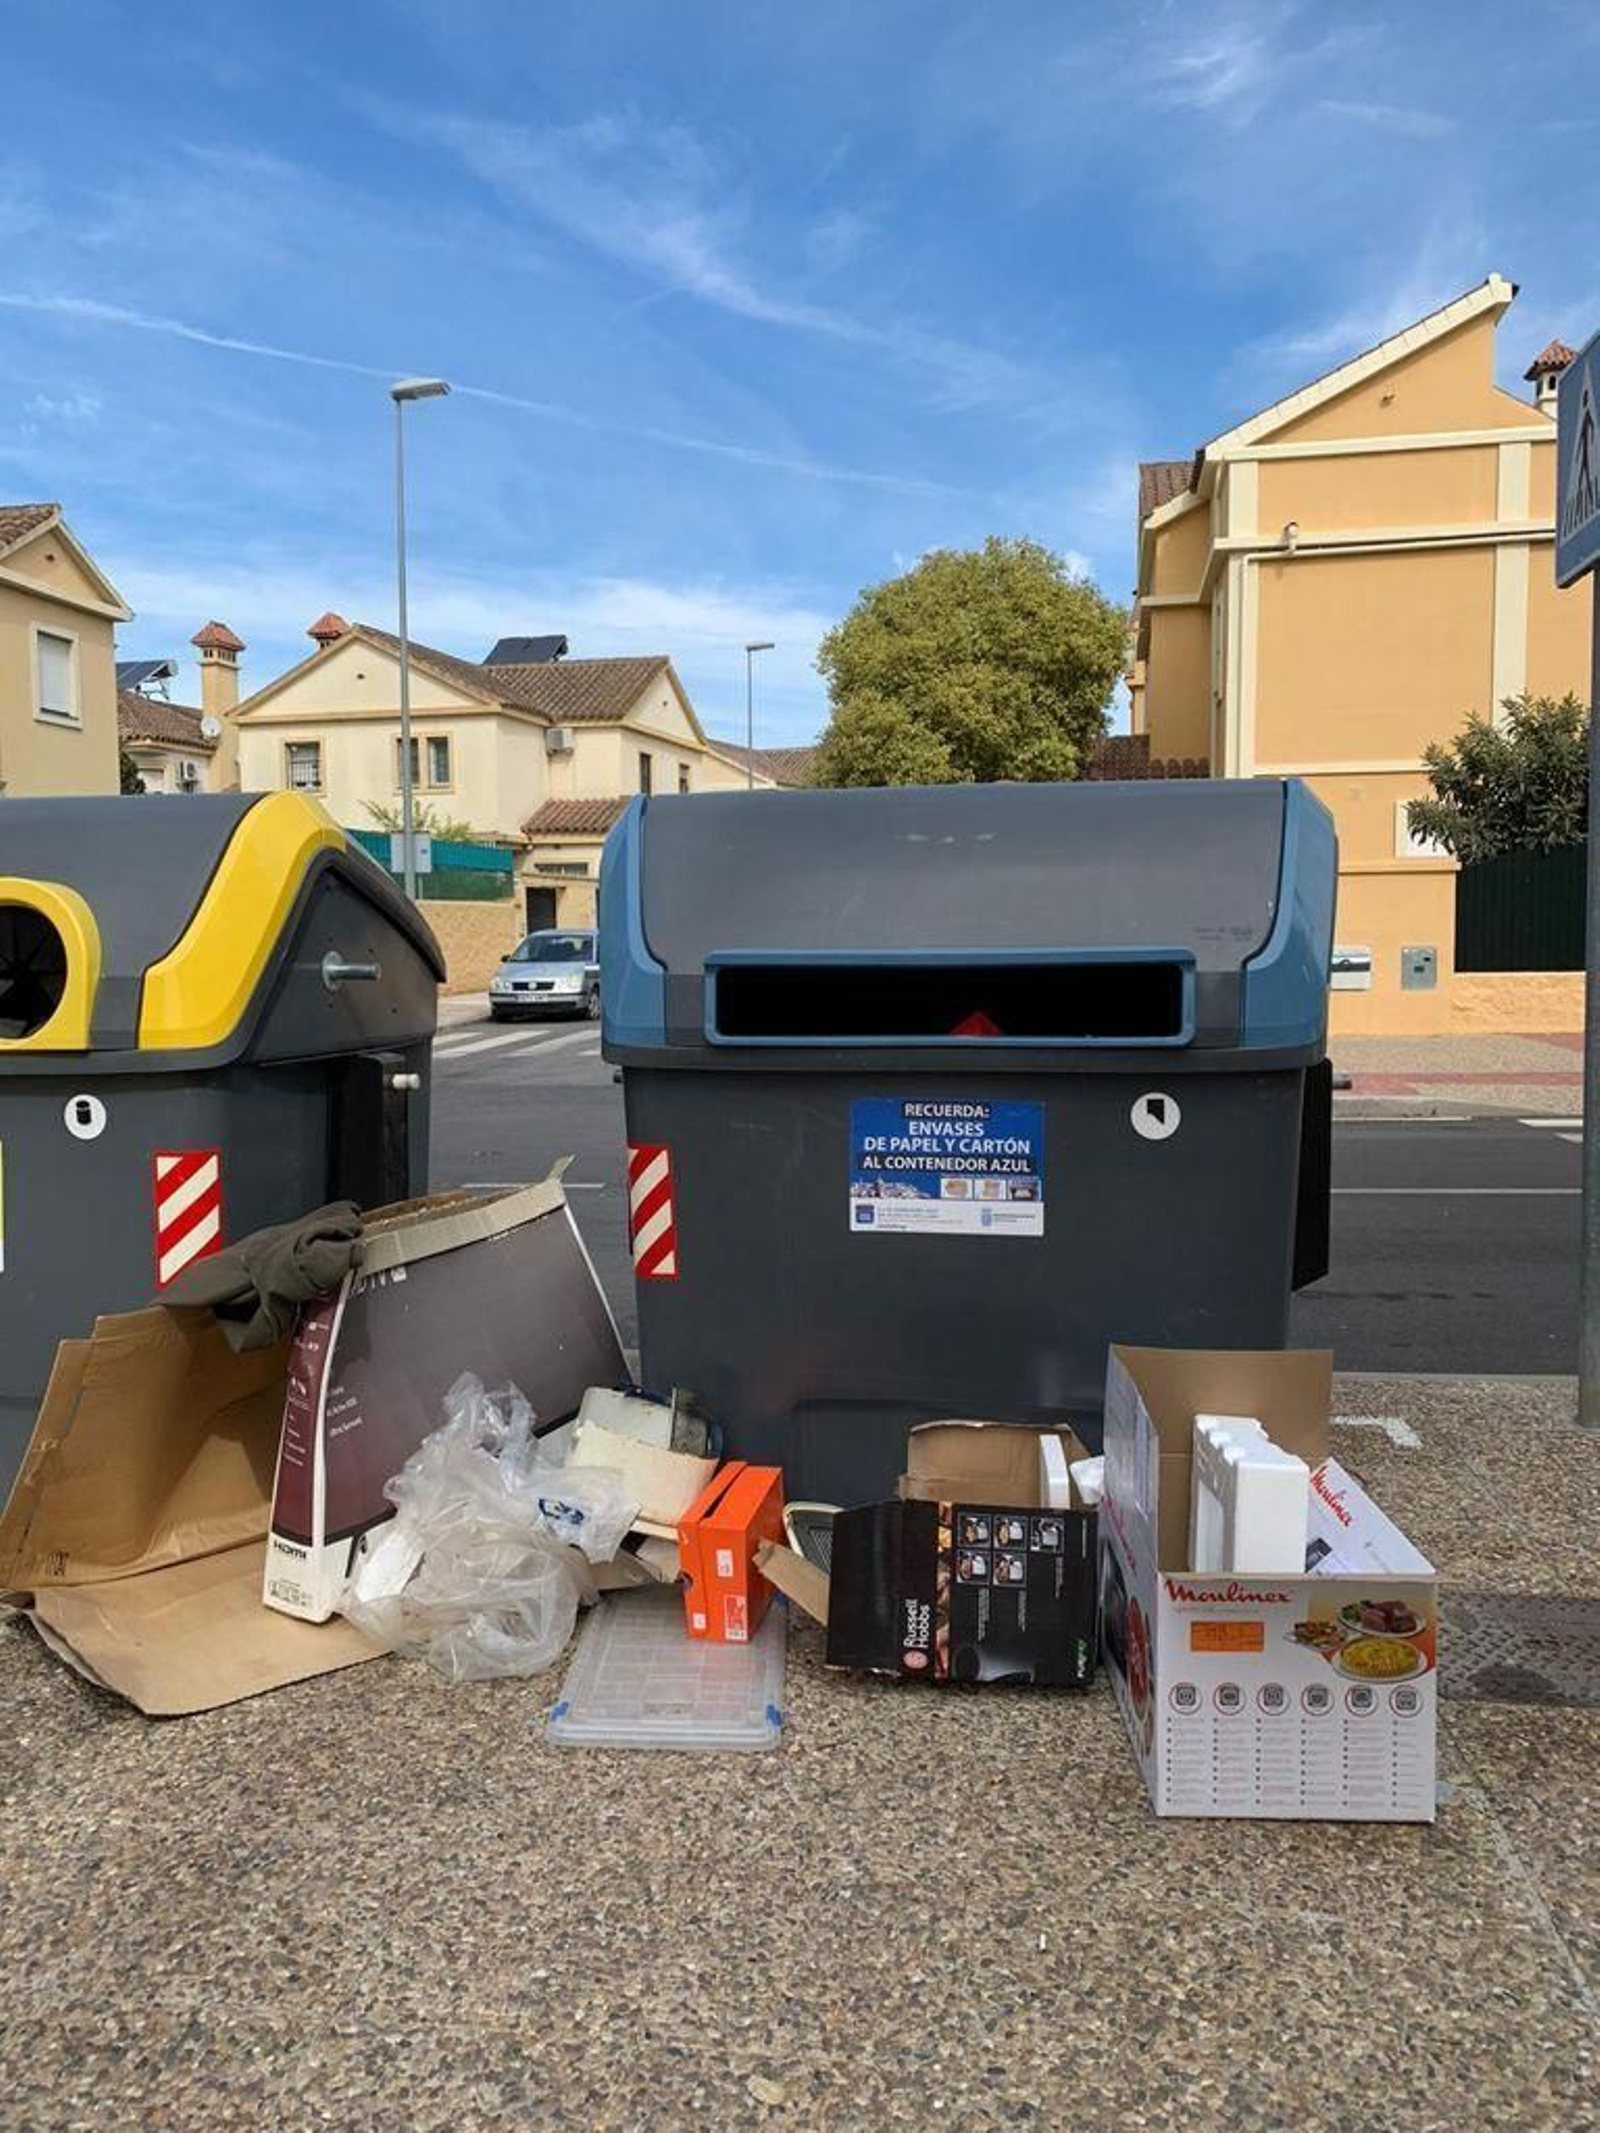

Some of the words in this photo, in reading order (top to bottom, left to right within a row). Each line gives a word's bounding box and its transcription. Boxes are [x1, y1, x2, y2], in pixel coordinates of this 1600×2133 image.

[904, 1103, 990, 1118] RECUERDA:
[909, 1121, 984, 1137] ENVASES
[864, 1137, 887, 1151] DE
[890, 1137, 942, 1153] PAPEL
[944, 1139, 956, 1152] Y
[959, 1136, 1030, 1154] CARTÓN
[863, 1156, 882, 1169] AL
[885, 1156, 988, 1171] CONTENEDOR
[990, 1159, 1031, 1172] AZUL
[1164, 1580, 1290, 1603] Moulinex
[903, 1599, 917, 1649] Russell
[917, 1605, 930, 1649] Hobbs
